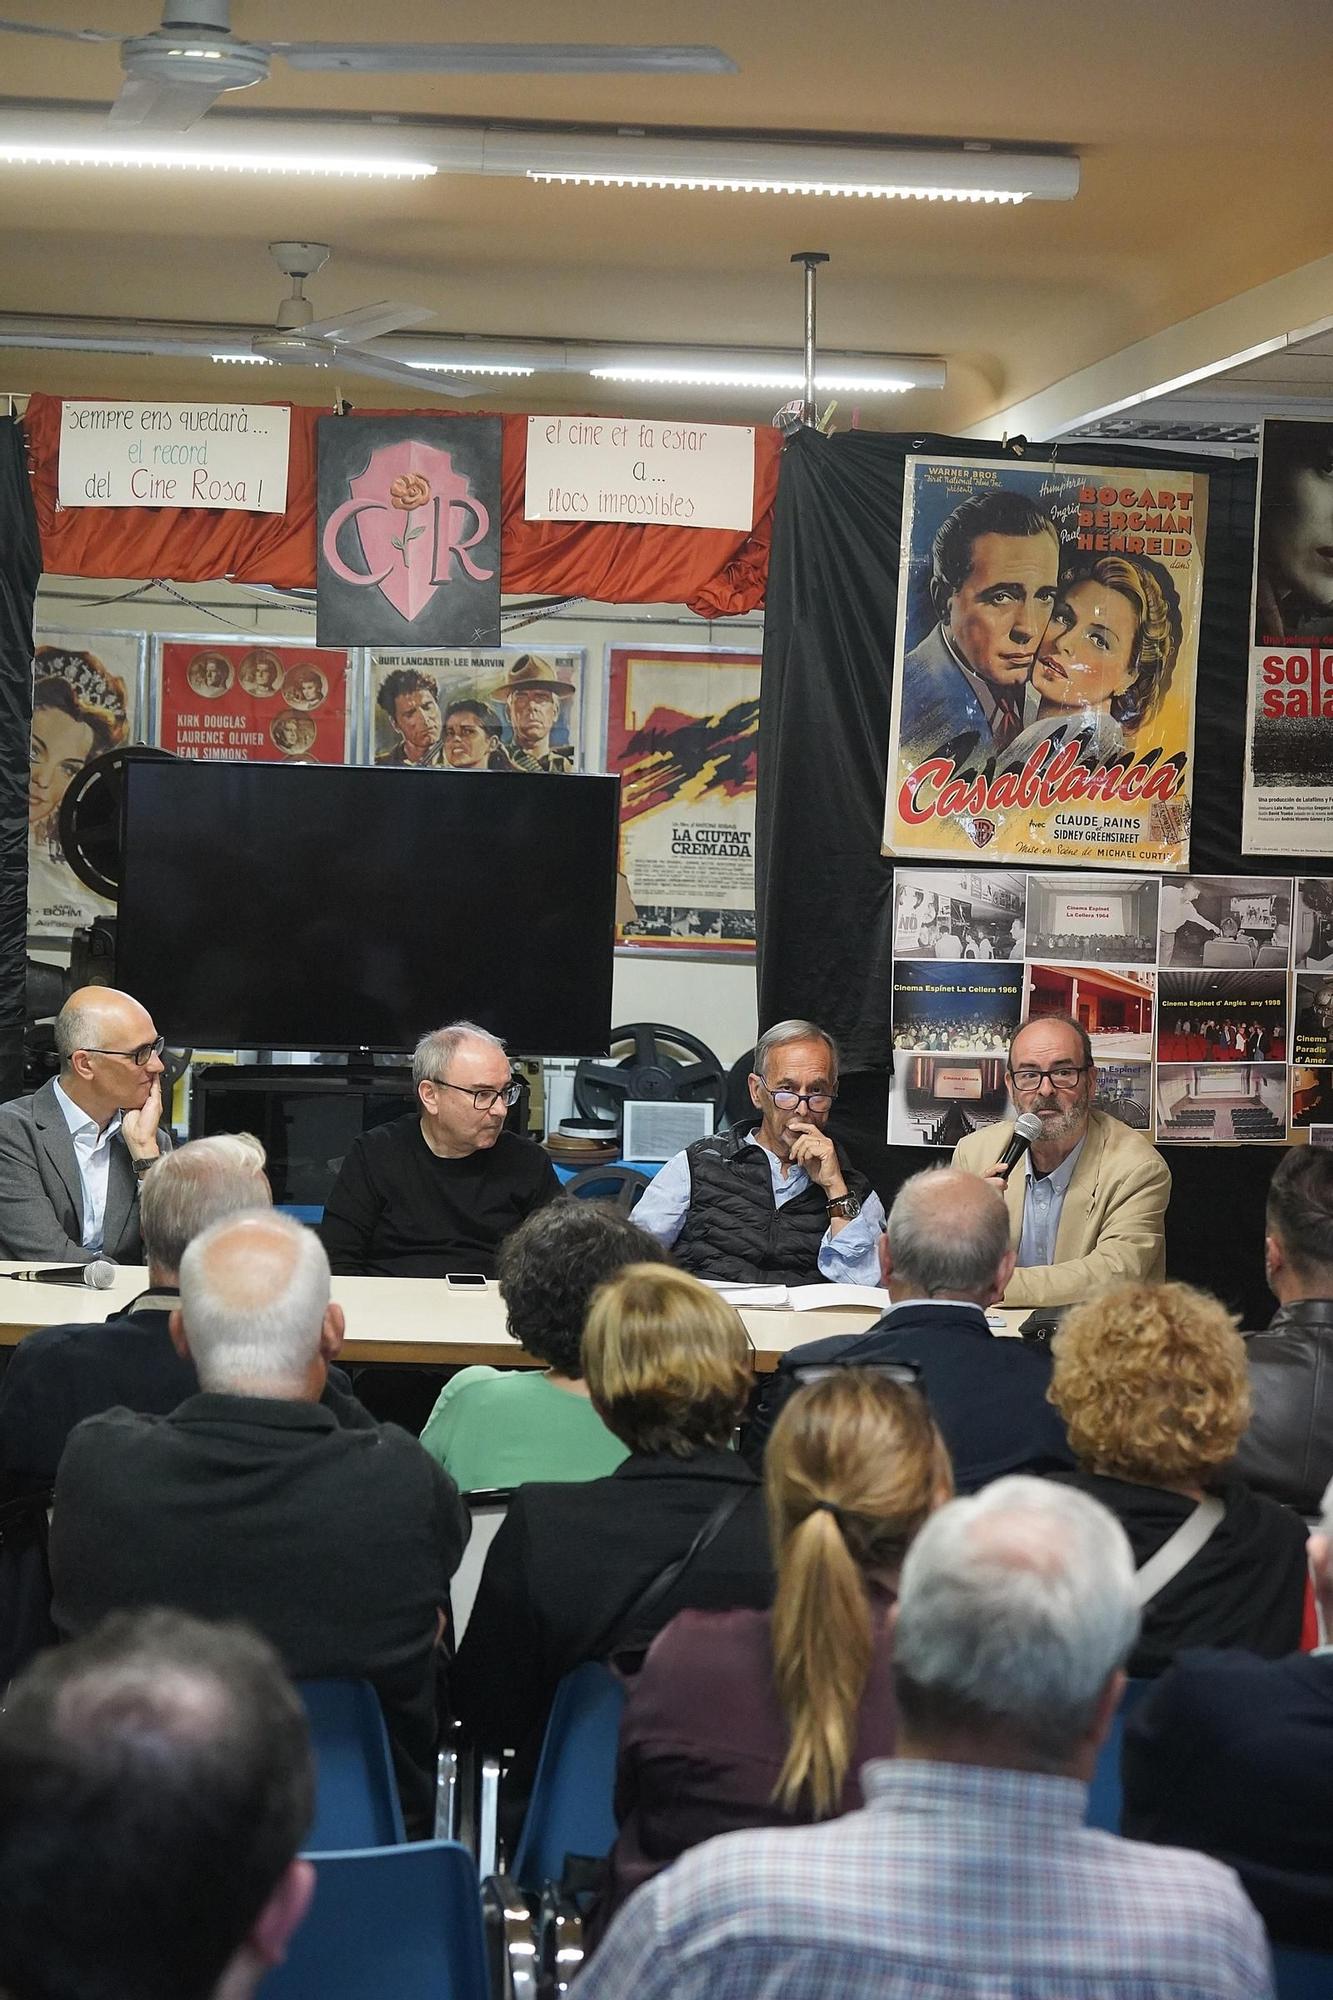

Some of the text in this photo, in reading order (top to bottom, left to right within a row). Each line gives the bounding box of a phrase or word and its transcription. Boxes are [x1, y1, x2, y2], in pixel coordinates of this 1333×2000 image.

[69, 409, 134, 430] sempre
[141, 410, 172, 431] ens
[546, 419, 562, 444] el
[568, 422, 603, 446] cine
[611, 425, 628, 447] et
[662, 428, 708, 451] estar
[128, 440, 208, 465] el record
[928, 467, 997, 479] WARNER BROS
[85, 471, 111, 498] del
[131, 468, 177, 499] Cine
[1039, 475, 1193, 511] Humphrey BOGART
[548, 488, 696, 517] llocs impossibles
[1050, 503, 1192, 535] Ingrid BERGMAN
[1060, 527, 1193, 557] Paul HENREID
[378, 657, 505, 668] BURT LANCASTER LEE MARVIN
[177, 714, 247, 729] KIRK DOUGLAS
[177, 730, 264, 746] LAURENCE OLIVIER
[176, 747, 248, 760] JEAN SIMMONS
[898, 739, 1179, 825] Casablanca
[1055, 814, 1098, 827] CLAUDE
[1103, 817, 1141, 829] RAINS
[672, 829, 751, 844] LA CIUTAT
[1053, 829, 1140, 844] SIDNEY GREENSTREET
[672, 842, 752, 857] CREMADA
[1097, 849, 1136, 858] MICHAEL
[894, 984, 923, 992] Cinema
